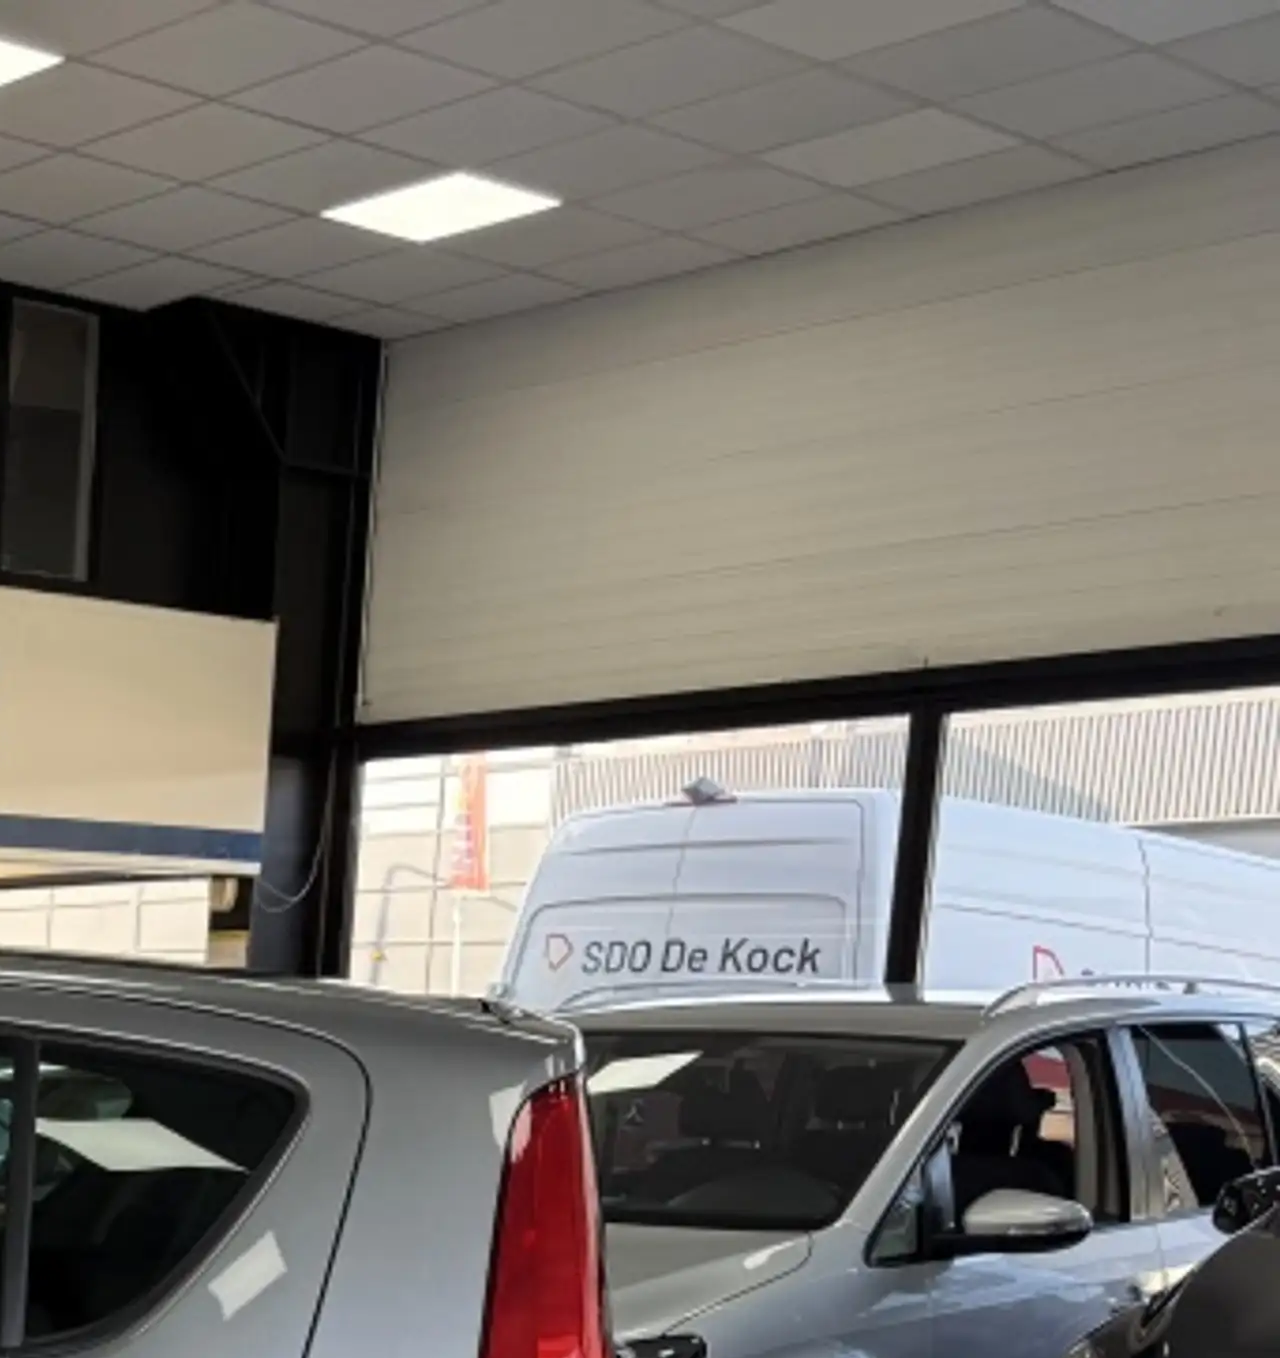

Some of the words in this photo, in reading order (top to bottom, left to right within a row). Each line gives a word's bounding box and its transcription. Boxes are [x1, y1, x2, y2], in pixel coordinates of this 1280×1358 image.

[581, 940, 652, 974] SDO
[660, 938, 708, 973] De
[718, 937, 821, 974] Kock
